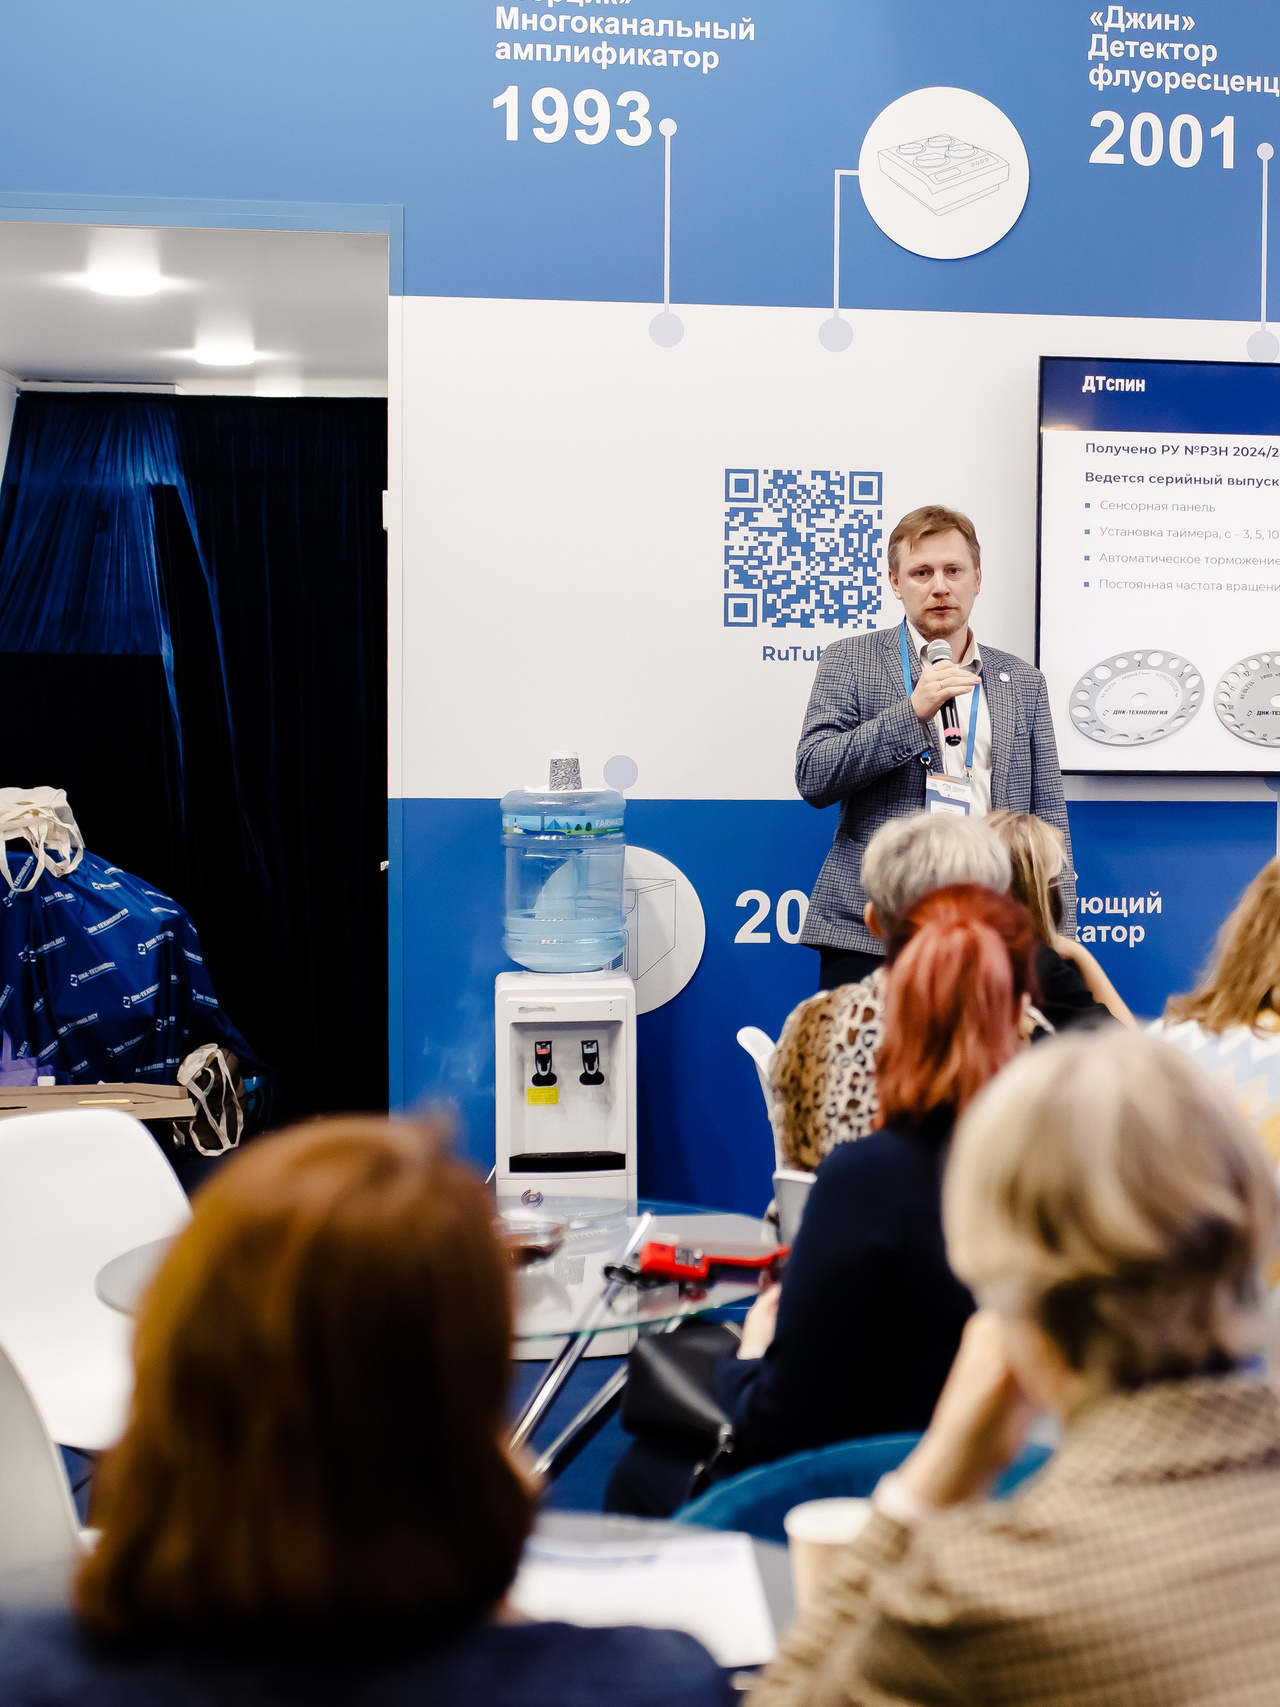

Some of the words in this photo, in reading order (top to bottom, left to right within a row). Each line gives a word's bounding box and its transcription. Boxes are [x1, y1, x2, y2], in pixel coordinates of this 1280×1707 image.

[495, 6, 755, 41] Многоканальный
[1089, 6, 1196, 33] «Джин»
[494, 41, 720, 74] амплификатор
[1088, 34, 1218, 66] Детектор
[492, 85, 653, 147] 1993
[1088, 110, 1235, 169] 2001
[1082, 375, 1146, 393] ДТспин
[1085, 443, 1157, 457] Получено
[1161, 444, 1180, 455] РУ
[1085, 472, 1144, 484] Ведется
[1148, 474, 1223, 487] серийный
[1227, 477, 1280, 488] выпуск
[1100, 500, 1168, 513] Сенсорная
[1171, 503, 1216, 513] панель
[1099, 526, 1164, 538] Установка
[1167, 528, 1222, 540] таймера,
[1243, 529, 1252, 540] 3,
[1255, 530, 1265, 541] 5,
[1267, 530, 1280, 540] 10
[1099, 553, 1201, 565] Автоматическое
[1099, 579, 1173, 591] Постоянная
[1176, 582, 1223, 591] частота
[734, 889, 809, 945] 20
[1076, 891, 1162, 918] ющий
